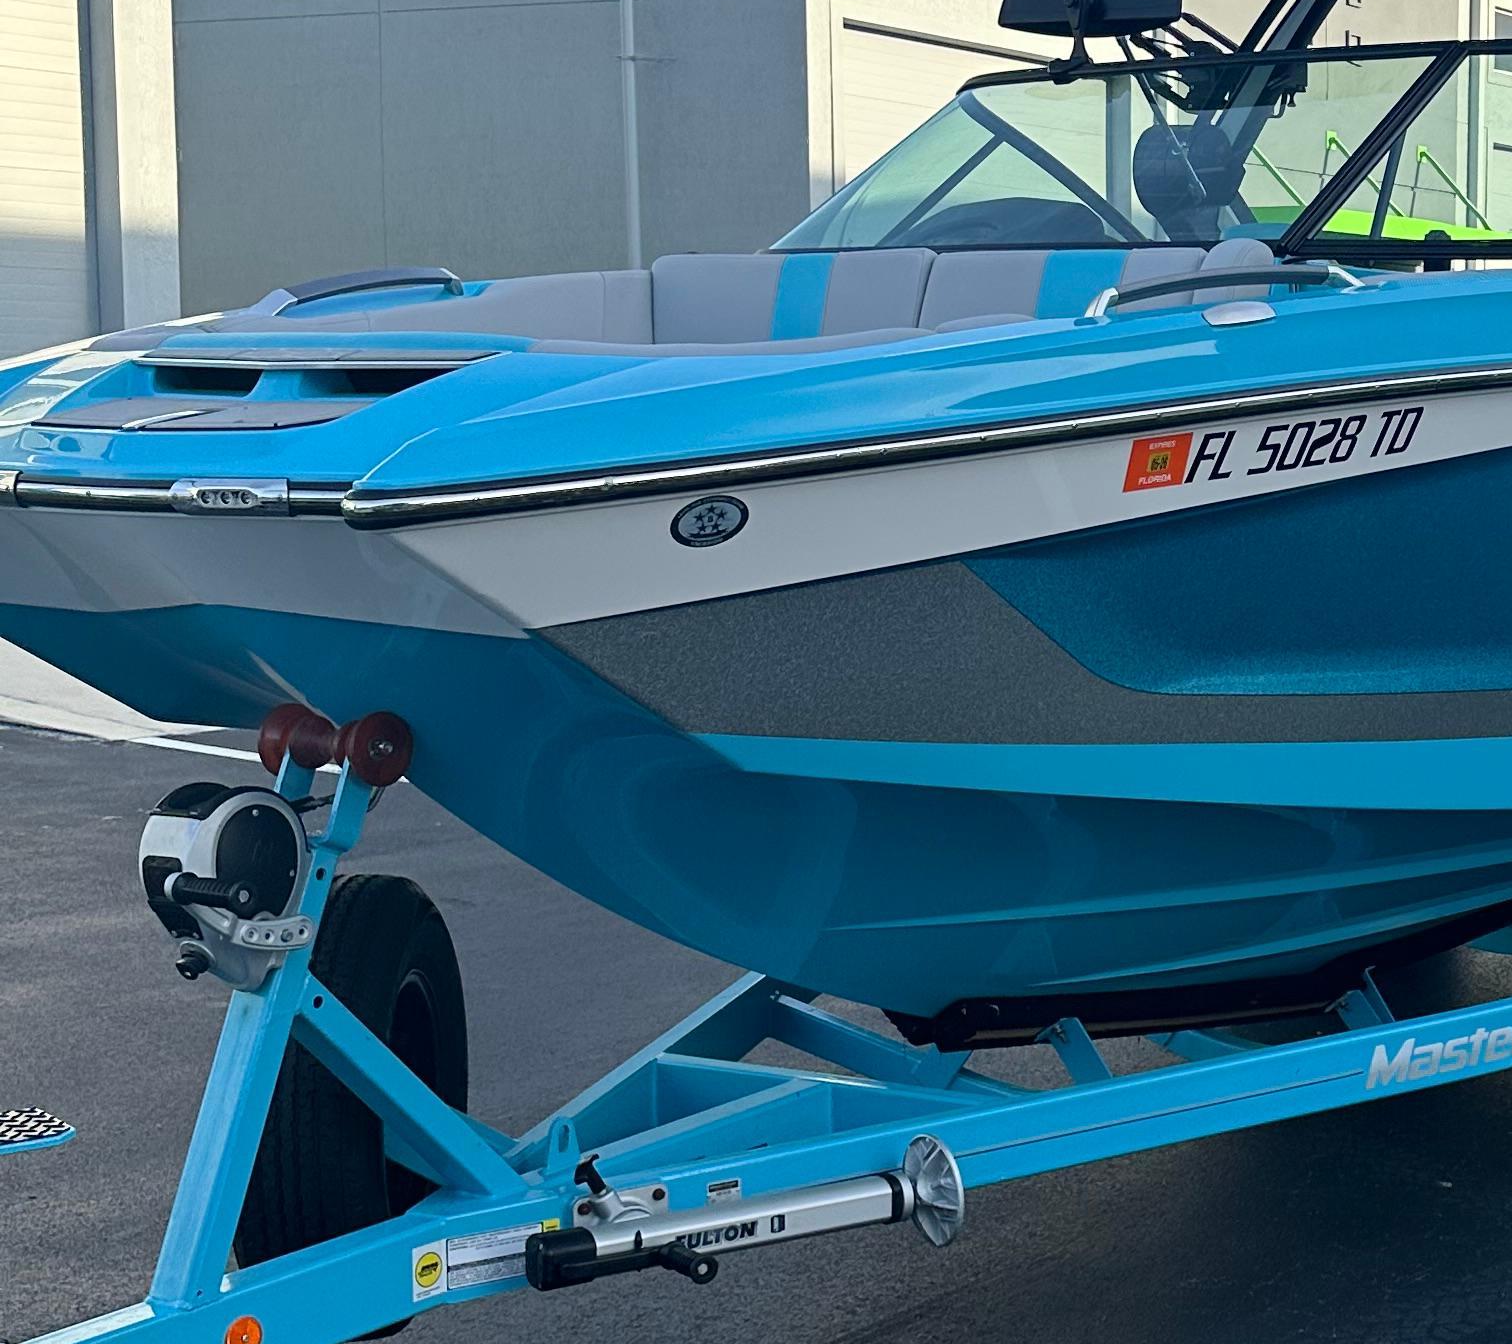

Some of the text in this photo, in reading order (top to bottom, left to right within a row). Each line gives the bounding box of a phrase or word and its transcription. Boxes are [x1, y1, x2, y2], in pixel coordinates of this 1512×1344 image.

[1184, 430, 1237, 484] FL
[1246, 414, 1367, 476] 5028
[1137, 473, 1172, 486] FLORIDA
